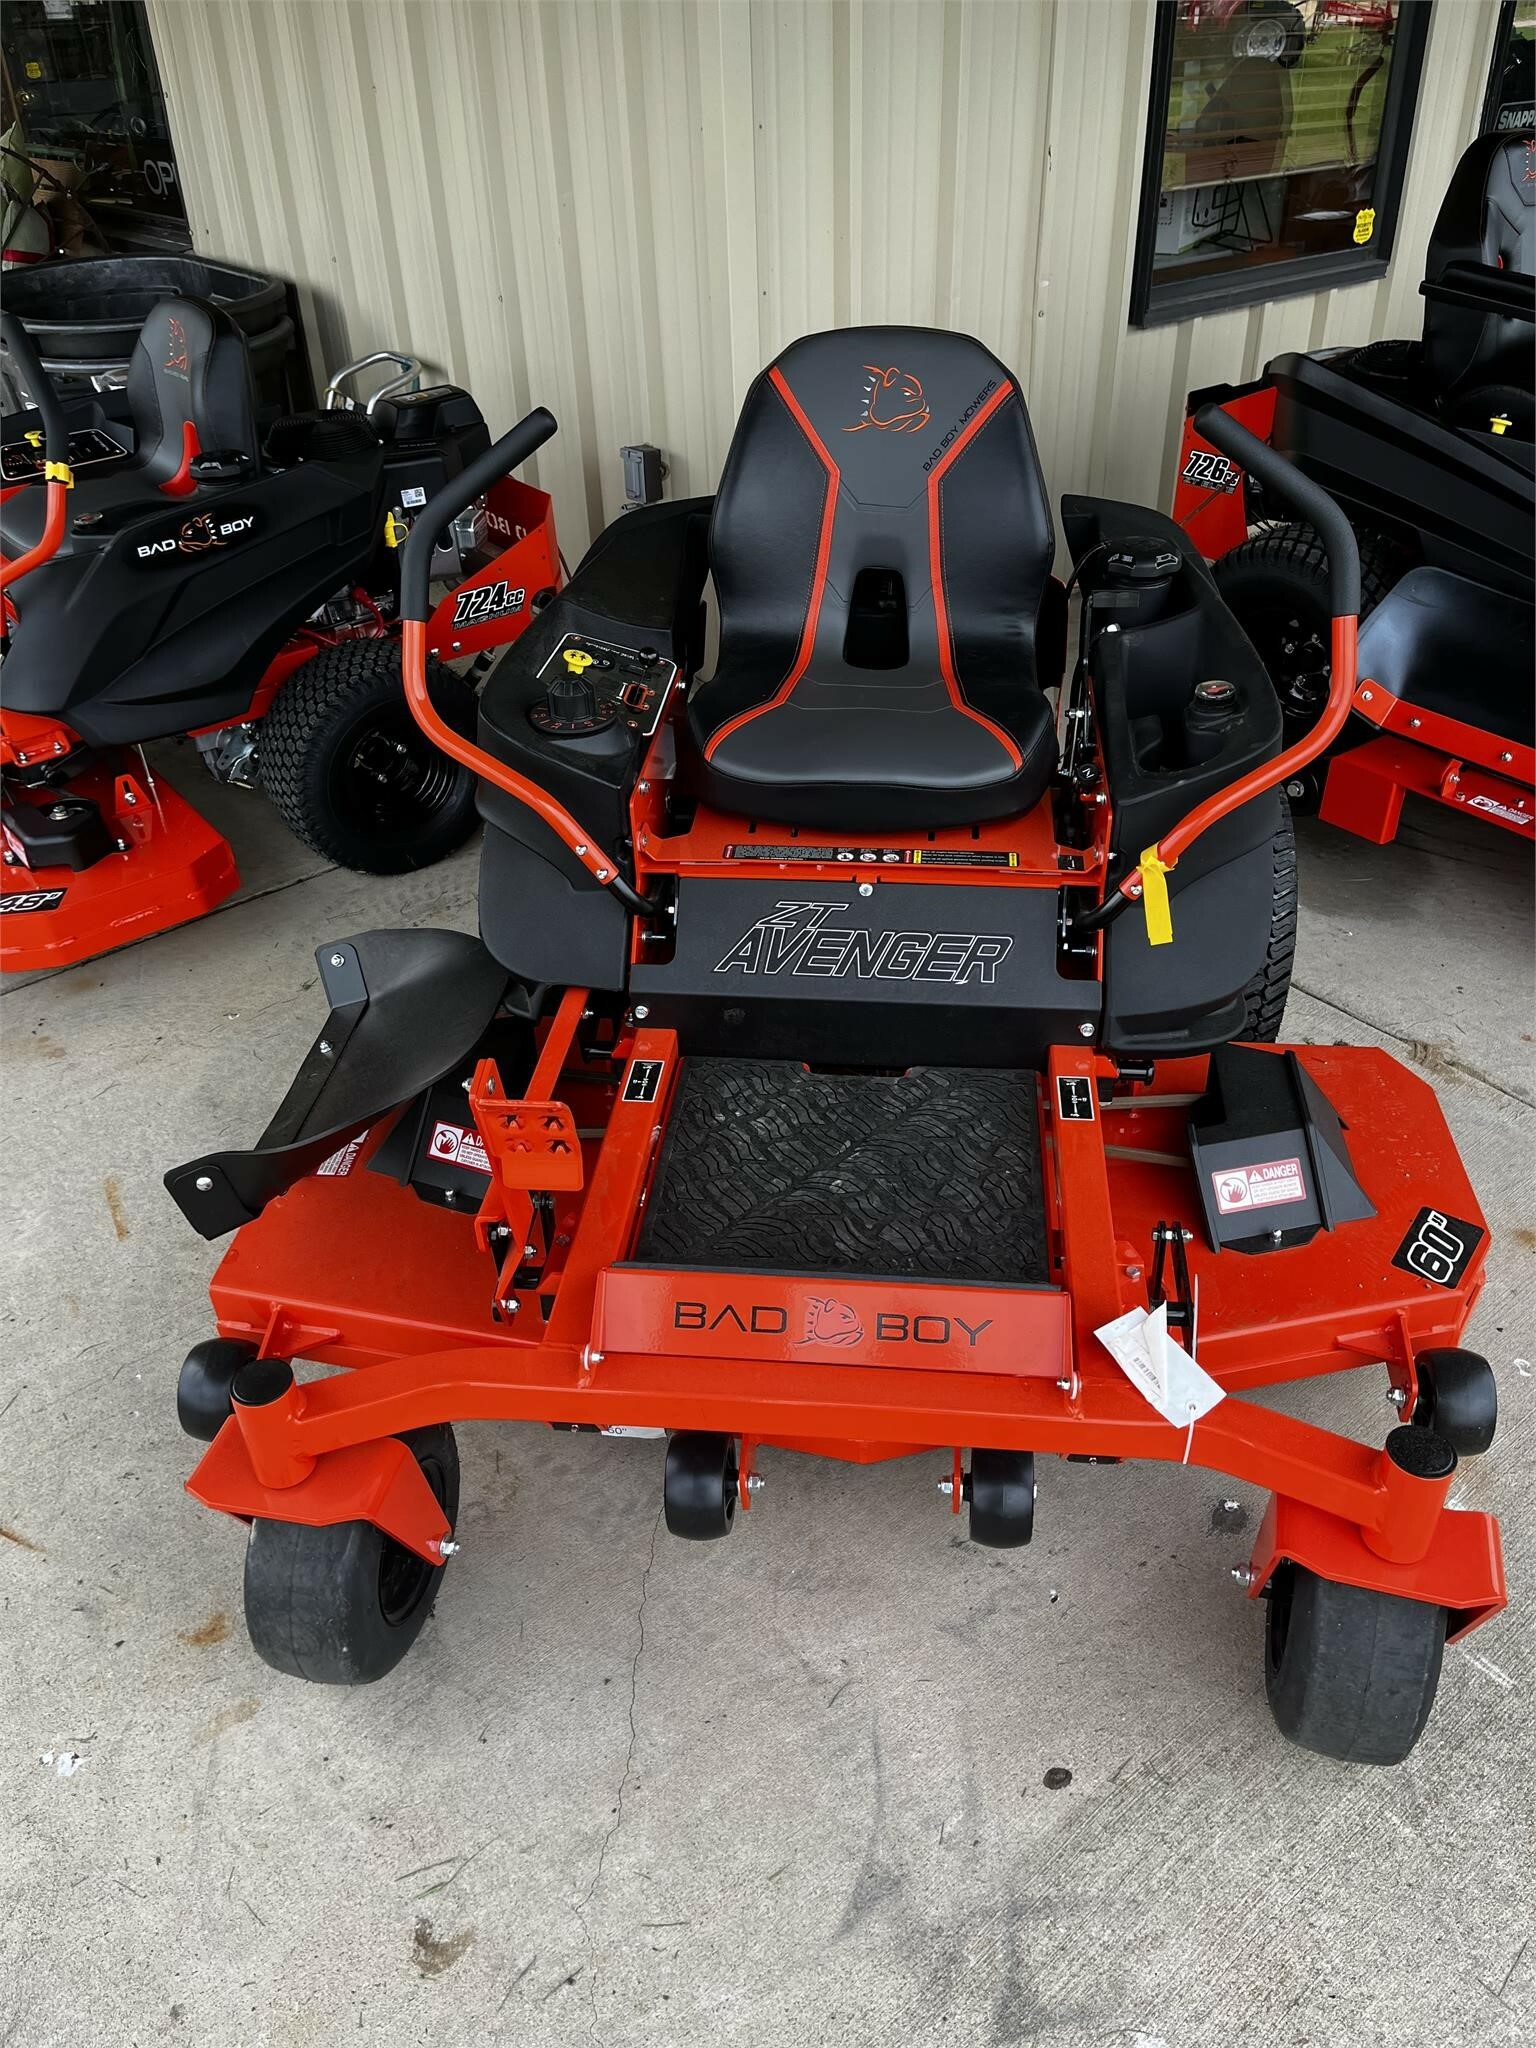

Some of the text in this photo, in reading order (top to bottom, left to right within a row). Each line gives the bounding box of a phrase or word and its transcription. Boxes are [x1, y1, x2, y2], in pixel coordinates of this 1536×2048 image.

[1498, 110, 1536, 130] SNAPP
[143, 159, 177, 195] OP
[922, 379, 997, 472] BAD BOY MOWERS
[137, 516, 254, 557] BAD BOY
[453, 580, 525, 622] 724cc
[755, 900, 849, 929] ZT
[713, 925, 1014, 984] AVENGER
[1262, 1163, 1299, 1180] DANGER
[1406, 1210, 1464, 1283] 60"
[674, 1301, 994, 1347] BAD BOY
